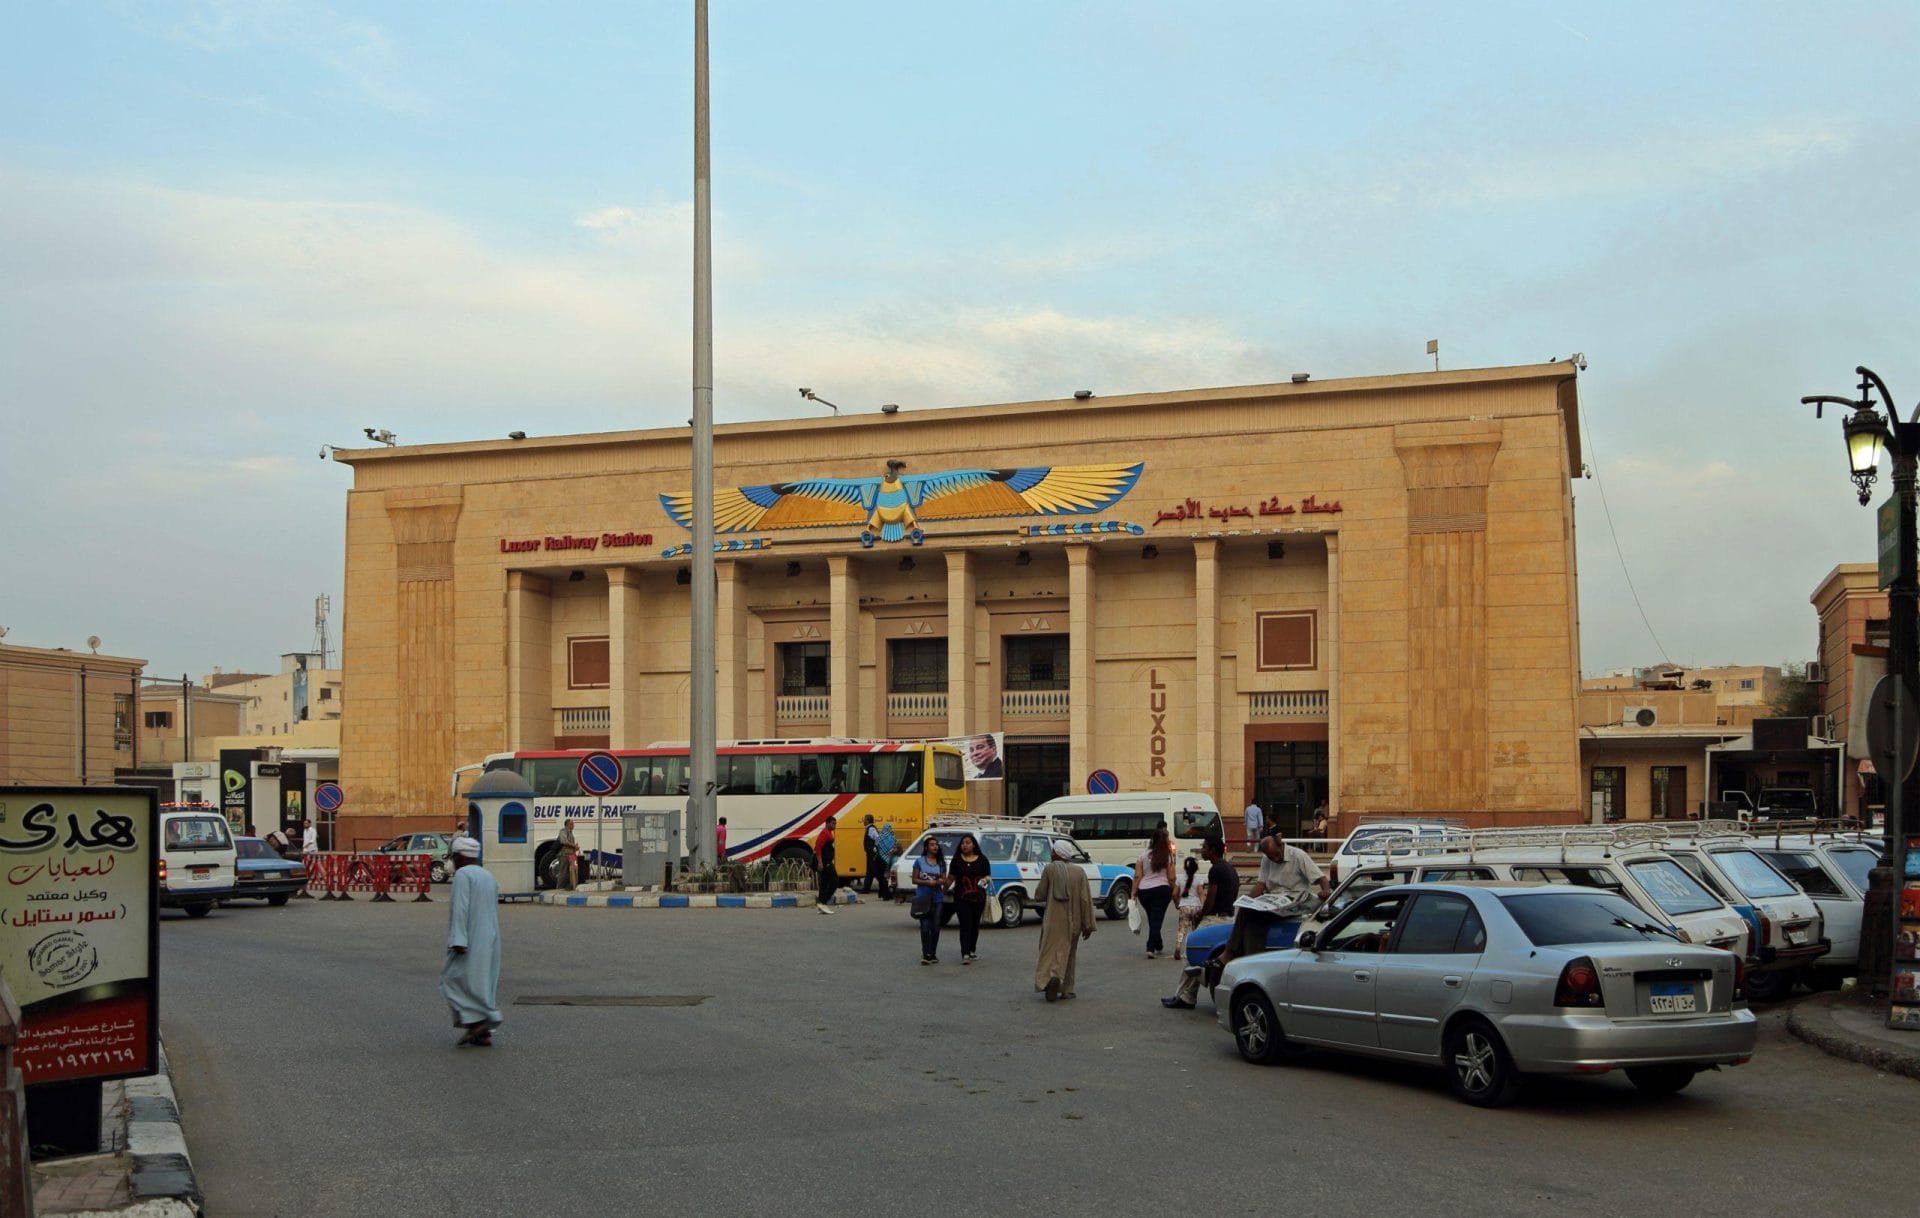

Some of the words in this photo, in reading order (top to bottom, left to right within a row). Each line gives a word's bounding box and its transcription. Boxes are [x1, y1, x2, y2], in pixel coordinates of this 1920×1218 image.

[1259, 496, 1296, 516] سكة
[1301, 495, 1343, 514] محطة
[1209, 503, 1254, 523] حديد
[500, 538, 542, 553] Luxor
[544, 535, 600, 552] Railway
[601, 531, 653, 548] Station
[1150, 669, 1166, 777] LUXOR
[534, 805, 561, 818] BLUE
[564, 805, 596, 818] WAVE
[0, 803, 137, 850] هدى
[8, 854, 115, 885] للعبايات
[26, 891, 69, 902] معتمد
[73, 889, 108, 902] وكيل
[32, 1026, 70, 1039] الحميد
[71, 1024, 99, 1034] عبد
[101, 1019, 135, 1033] شارع
[107, 1033, 135, 1045] شارع
